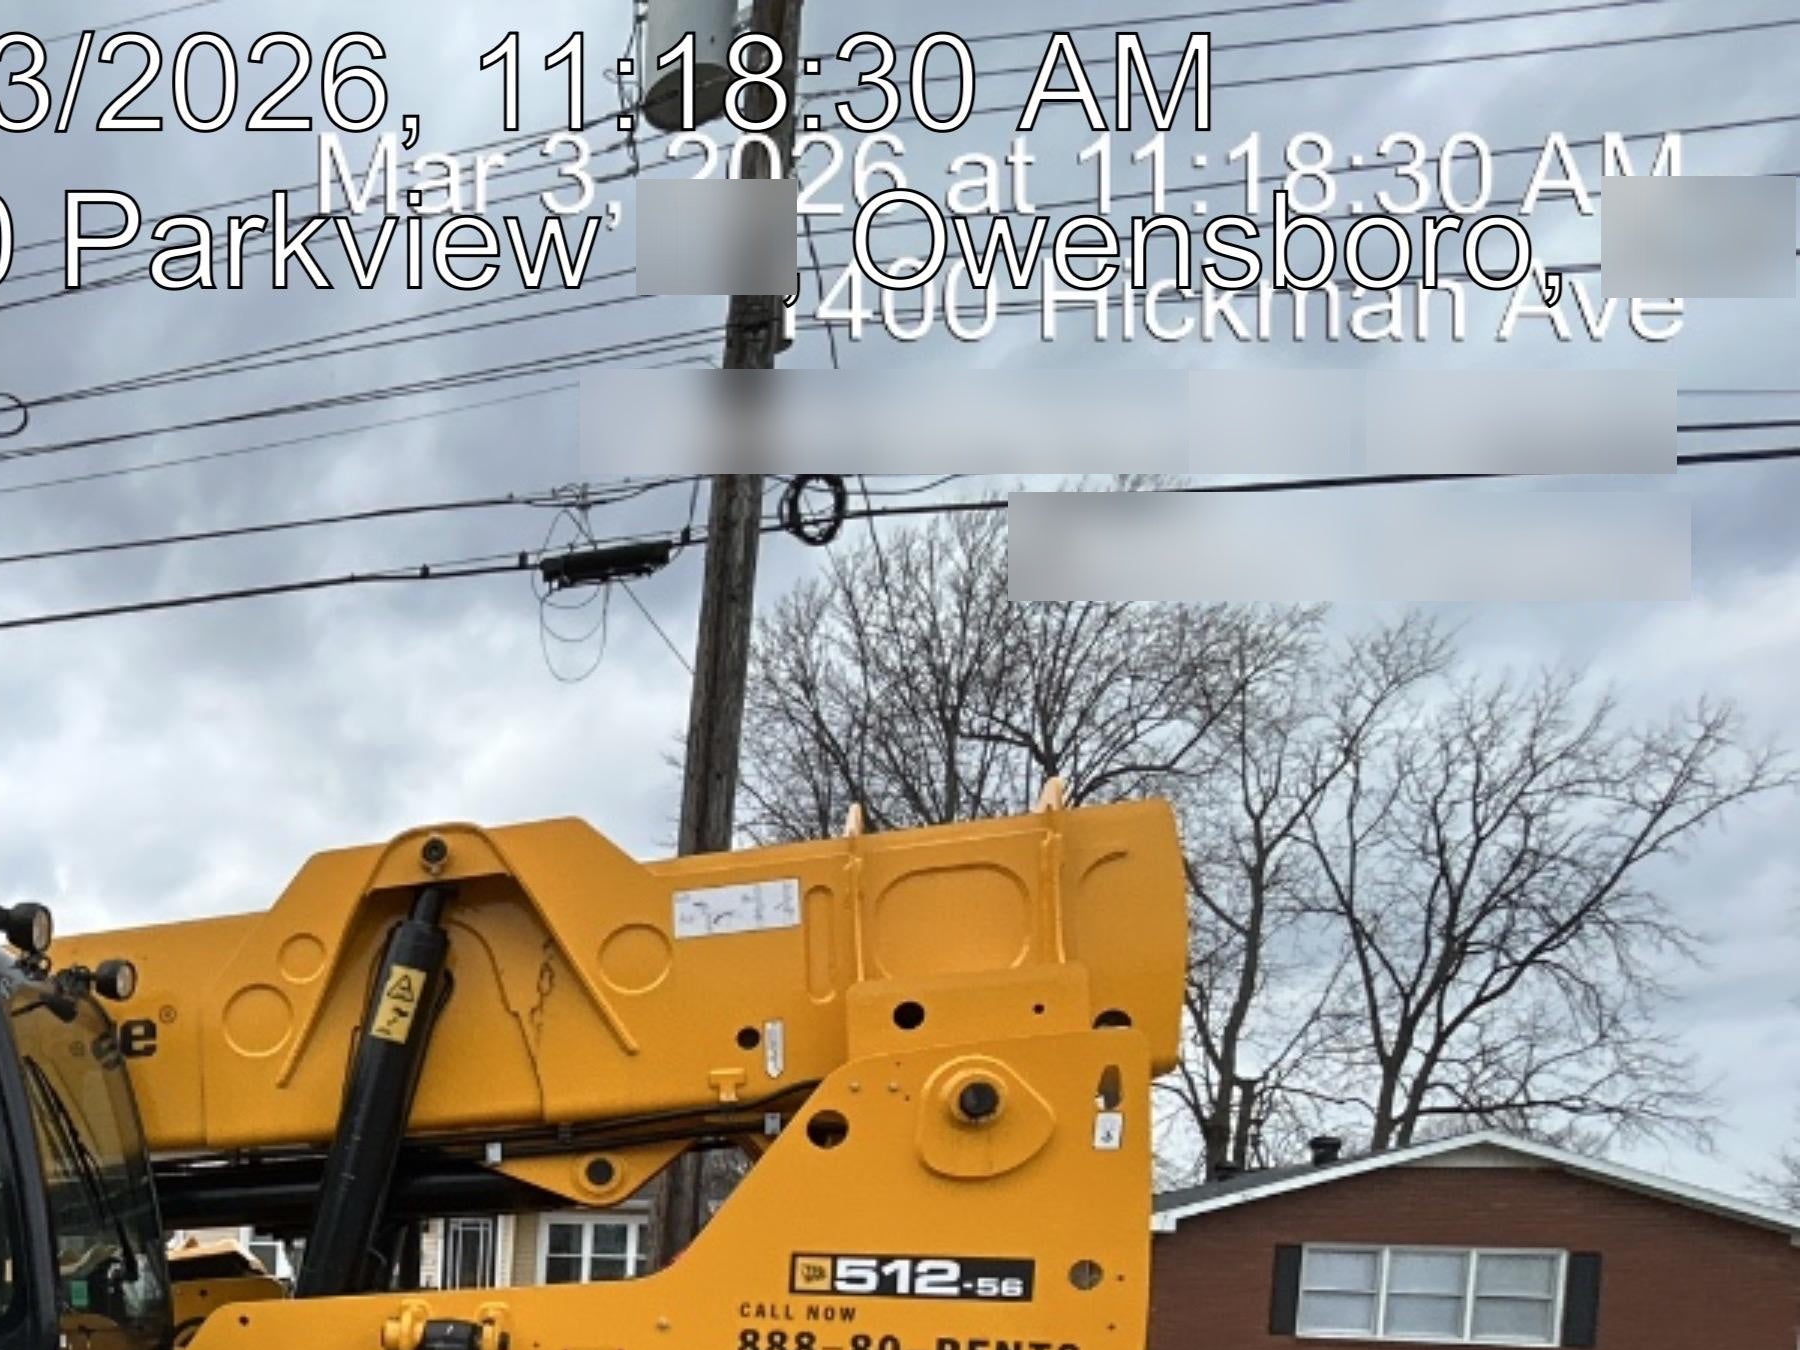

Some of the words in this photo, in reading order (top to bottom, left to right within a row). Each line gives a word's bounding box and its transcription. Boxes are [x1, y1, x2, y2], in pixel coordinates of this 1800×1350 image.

[833, 1257, 1024, 1298] 512-56
[740, 1303, 795, 1321] CALL
[806, 1306, 857, 1322] NOW
